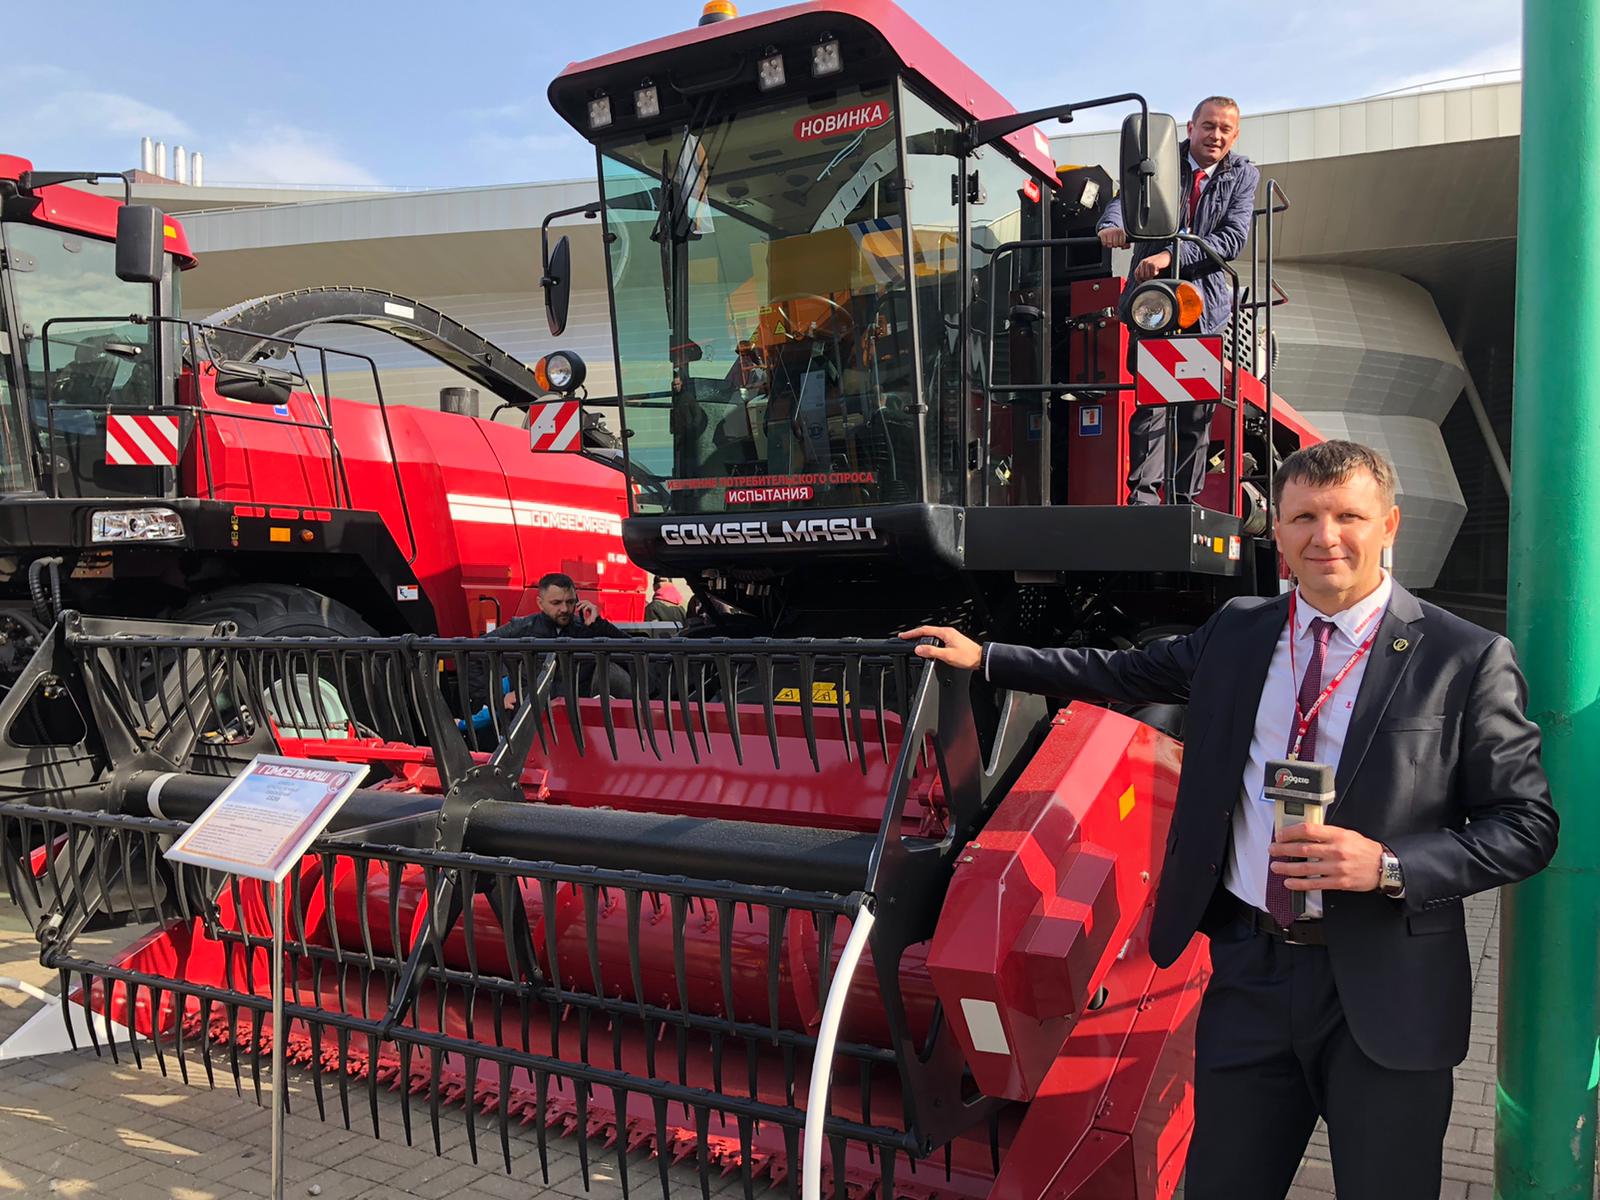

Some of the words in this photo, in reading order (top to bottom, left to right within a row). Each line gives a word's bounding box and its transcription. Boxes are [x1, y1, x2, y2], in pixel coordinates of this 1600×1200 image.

[801, 105, 882, 138] НОВИНКА
[719, 473, 826, 487] ПОТРЕБИТЕЛЬСКОГО
[829, 472, 875, 484] СПРОСА
[728, 487, 809, 502] ИСПЫТАНИЯ
[660, 517, 877, 545] GOMSELMASH
[258, 764, 331, 782] ГОМСЕЛЬМАШ
